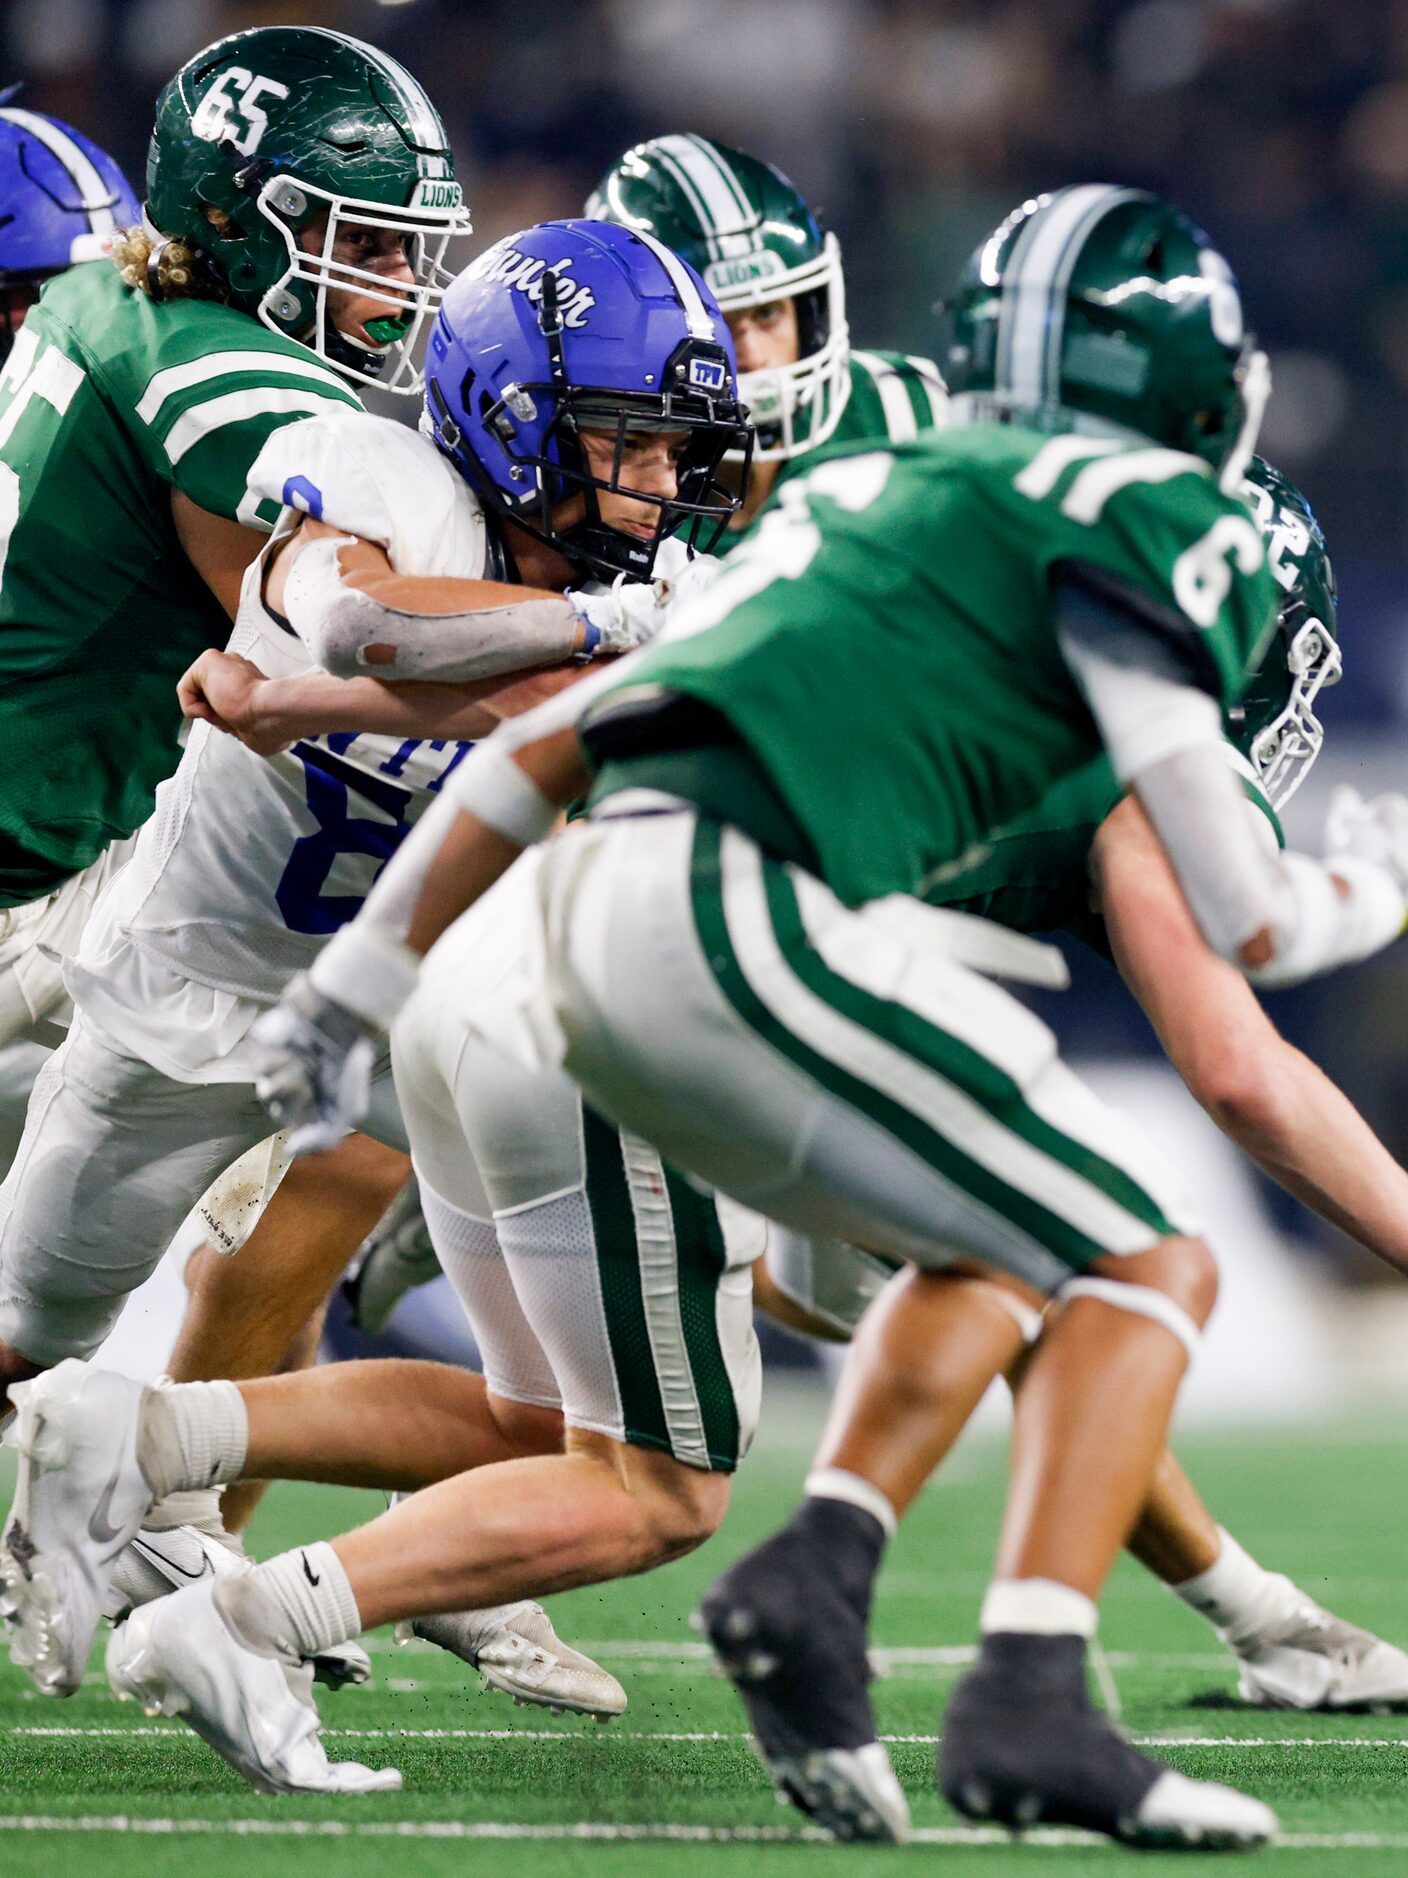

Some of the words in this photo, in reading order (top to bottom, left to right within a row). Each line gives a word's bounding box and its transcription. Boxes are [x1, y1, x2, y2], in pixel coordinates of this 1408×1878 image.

[191, 66, 290, 157] 65
[420, 184, 461, 208] LIONS
[712, 261, 775, 289] LIONS
[695, 362, 722, 386] TPW
[1172, 515, 1264, 628] 6
